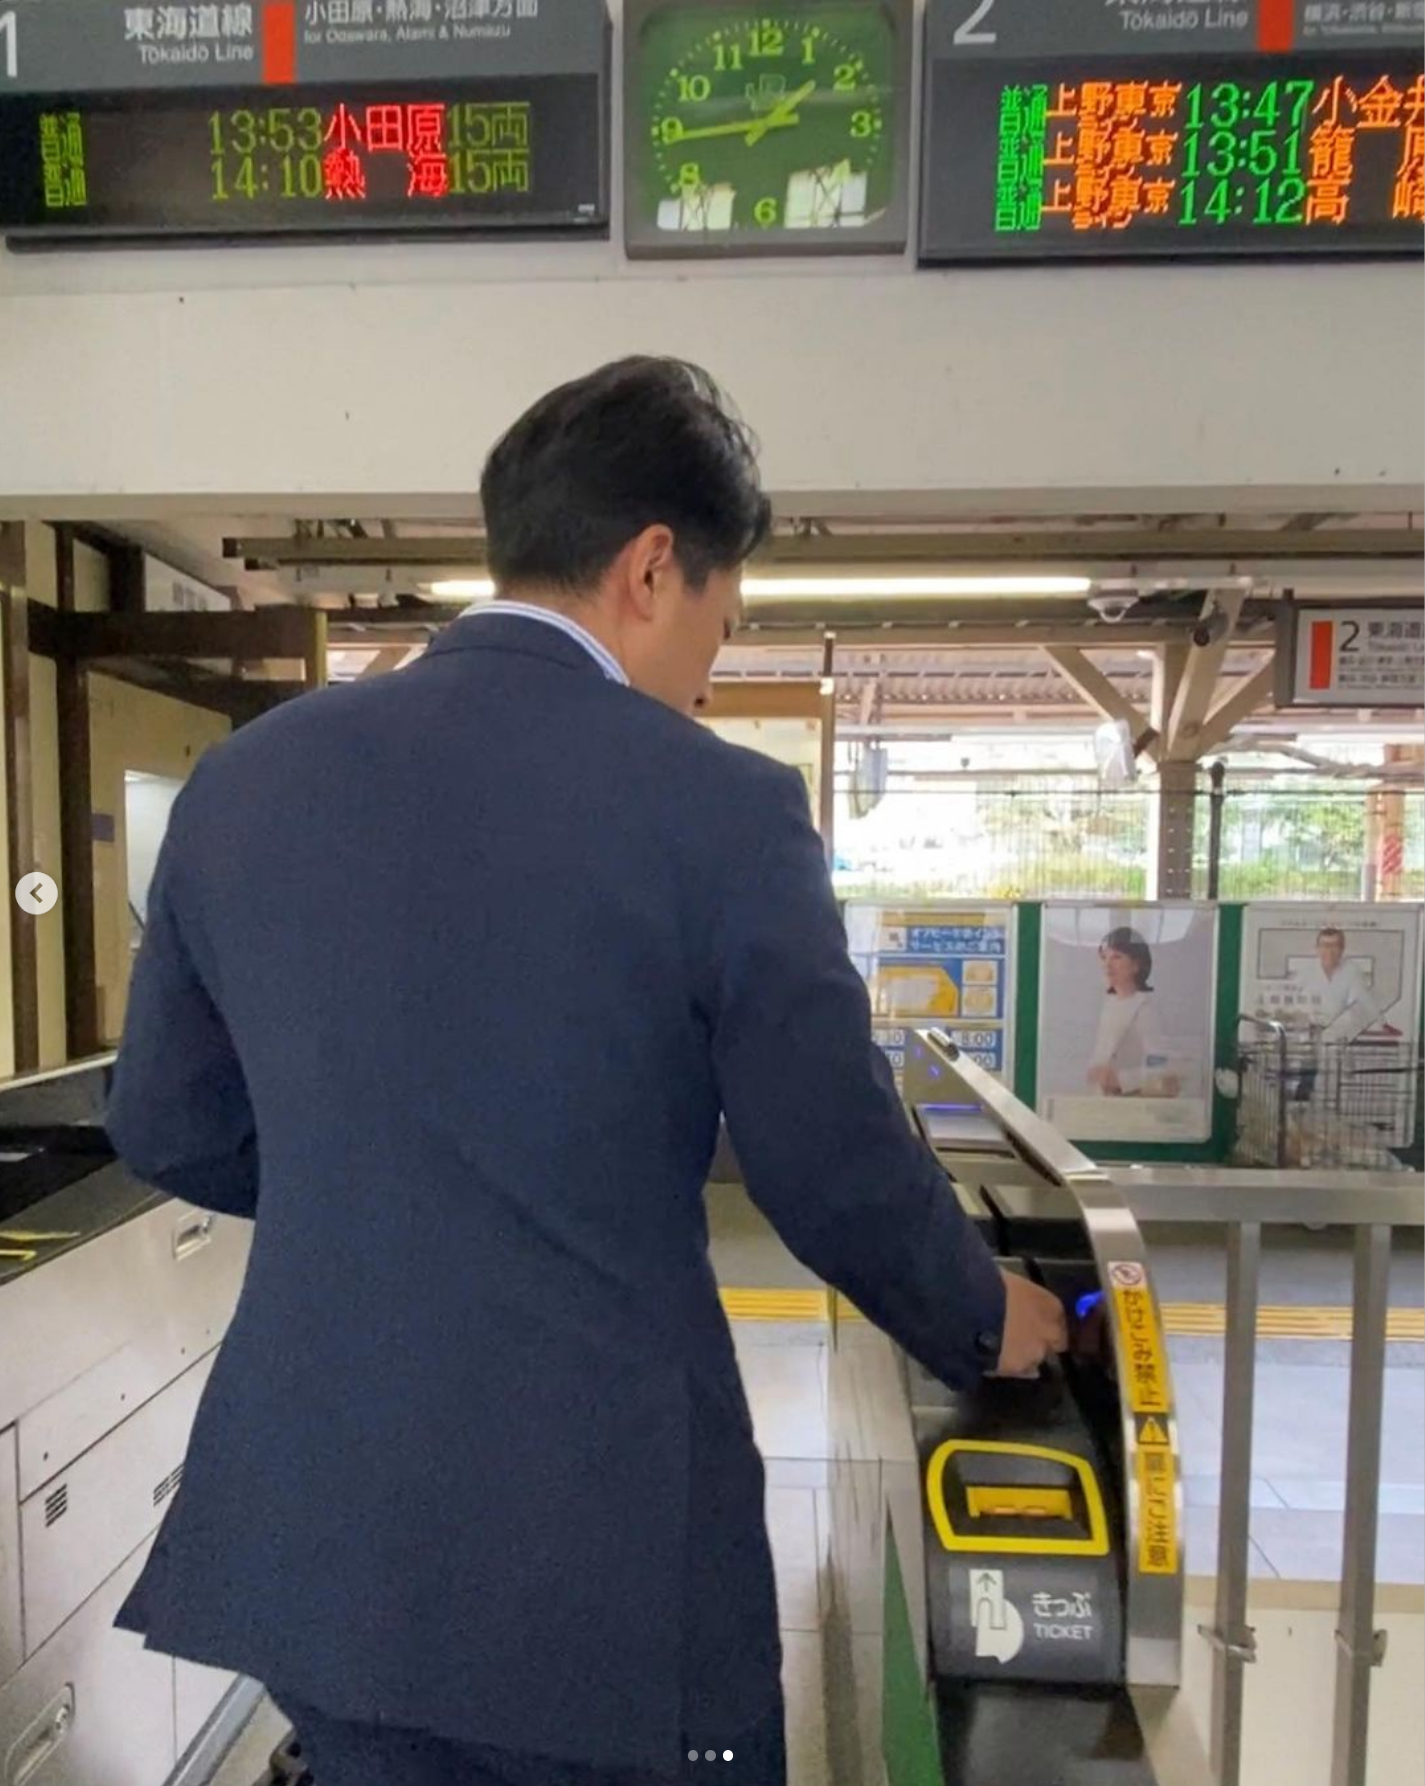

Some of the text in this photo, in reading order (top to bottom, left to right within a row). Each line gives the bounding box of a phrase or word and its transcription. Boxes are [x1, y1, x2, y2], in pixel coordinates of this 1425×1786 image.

[124, 4, 253, 40] 東海道線
[953, 0, 997, 44] 2
[1205, 8, 1249, 29] Line
[0, 11, 17, 77] 1
[215, 42, 253, 61] Line
[749, 28, 784, 56] 12
[802, 36, 815, 64] 1
[714, 44, 743, 71] 11
[678, 75, 711, 102] 10
[833, 65, 856, 91] 2
[999, 84, 1047, 136] 普通
[1185, 80, 1314, 129] 13:47
[208, 107, 322, 155] 13:53
[324, 103, 445, 151] 小田原
[448, 102, 530, 147] 15両
[661, 116, 684, 144] 9
[850, 111, 872, 137] 3
[997, 135, 1044, 184] 普通
[1181, 130, 1301, 177] 13:51
[211, 154, 323, 199] 14:10
[325, 149, 447, 199] 熱海
[450, 149, 530, 193] 15両
[754, 198, 777, 225] 6
[995, 183, 1042, 231] 普通
[1178, 177, 1305, 225] 14:12
[1339, 620, 1360, 652] 2
[1031, 1591, 1092, 1618] きっぷ
[1033, 1623, 1093, 1640] TICKET
